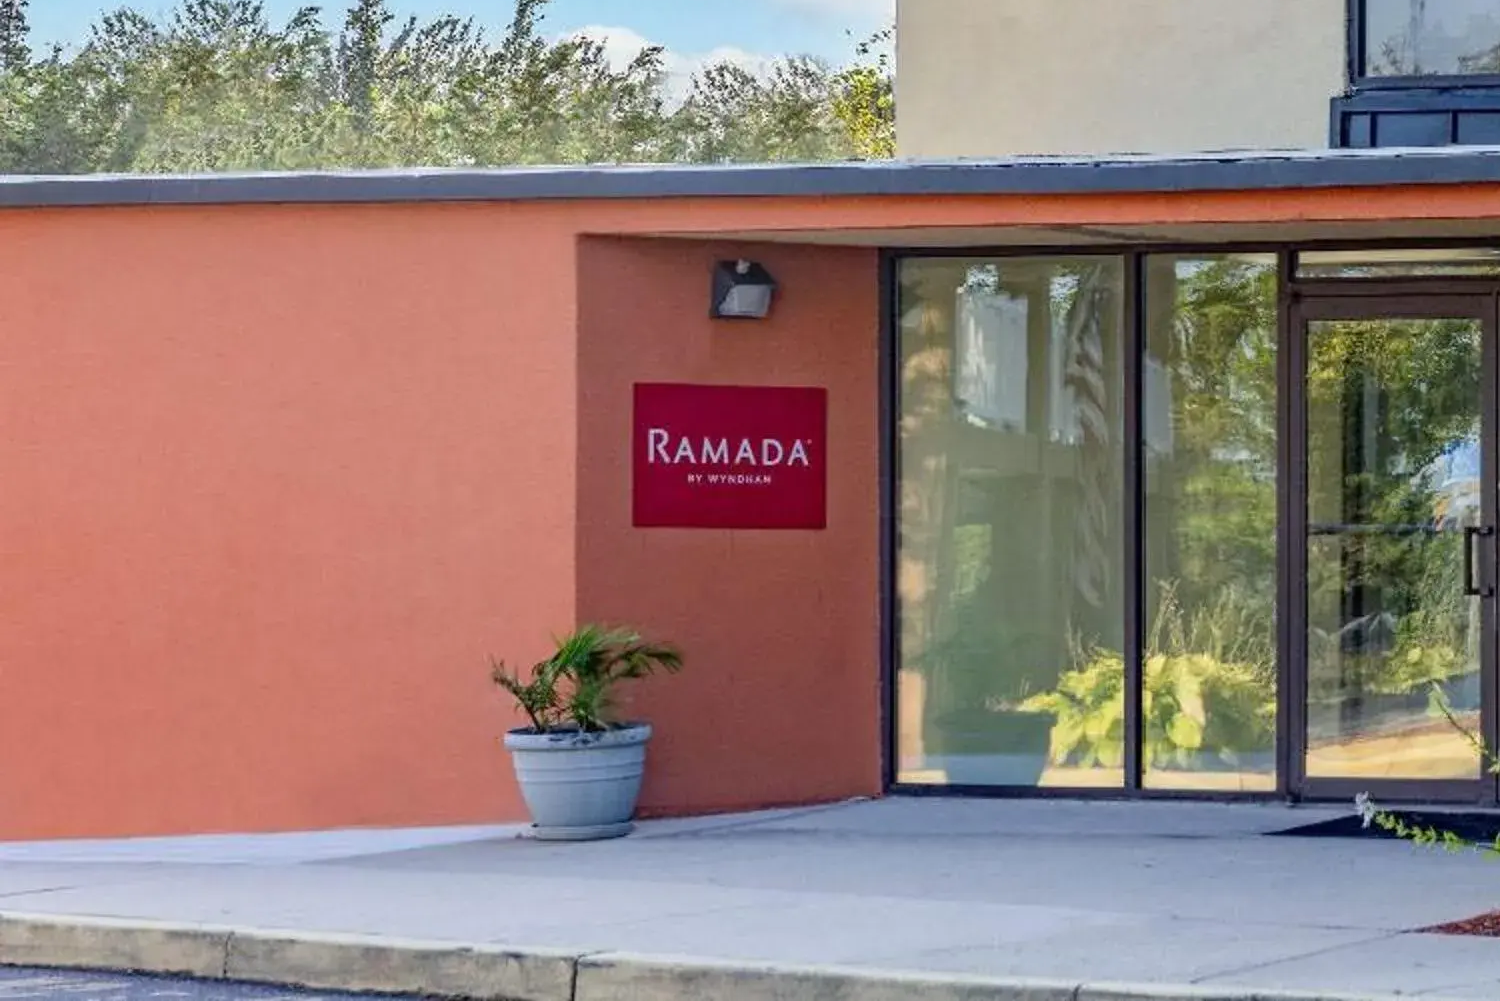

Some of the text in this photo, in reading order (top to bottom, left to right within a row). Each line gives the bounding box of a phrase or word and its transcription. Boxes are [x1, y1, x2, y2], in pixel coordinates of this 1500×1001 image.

[648, 428, 809, 466] RAMADA
[688, 474, 772, 484] BY WYNDHAM
